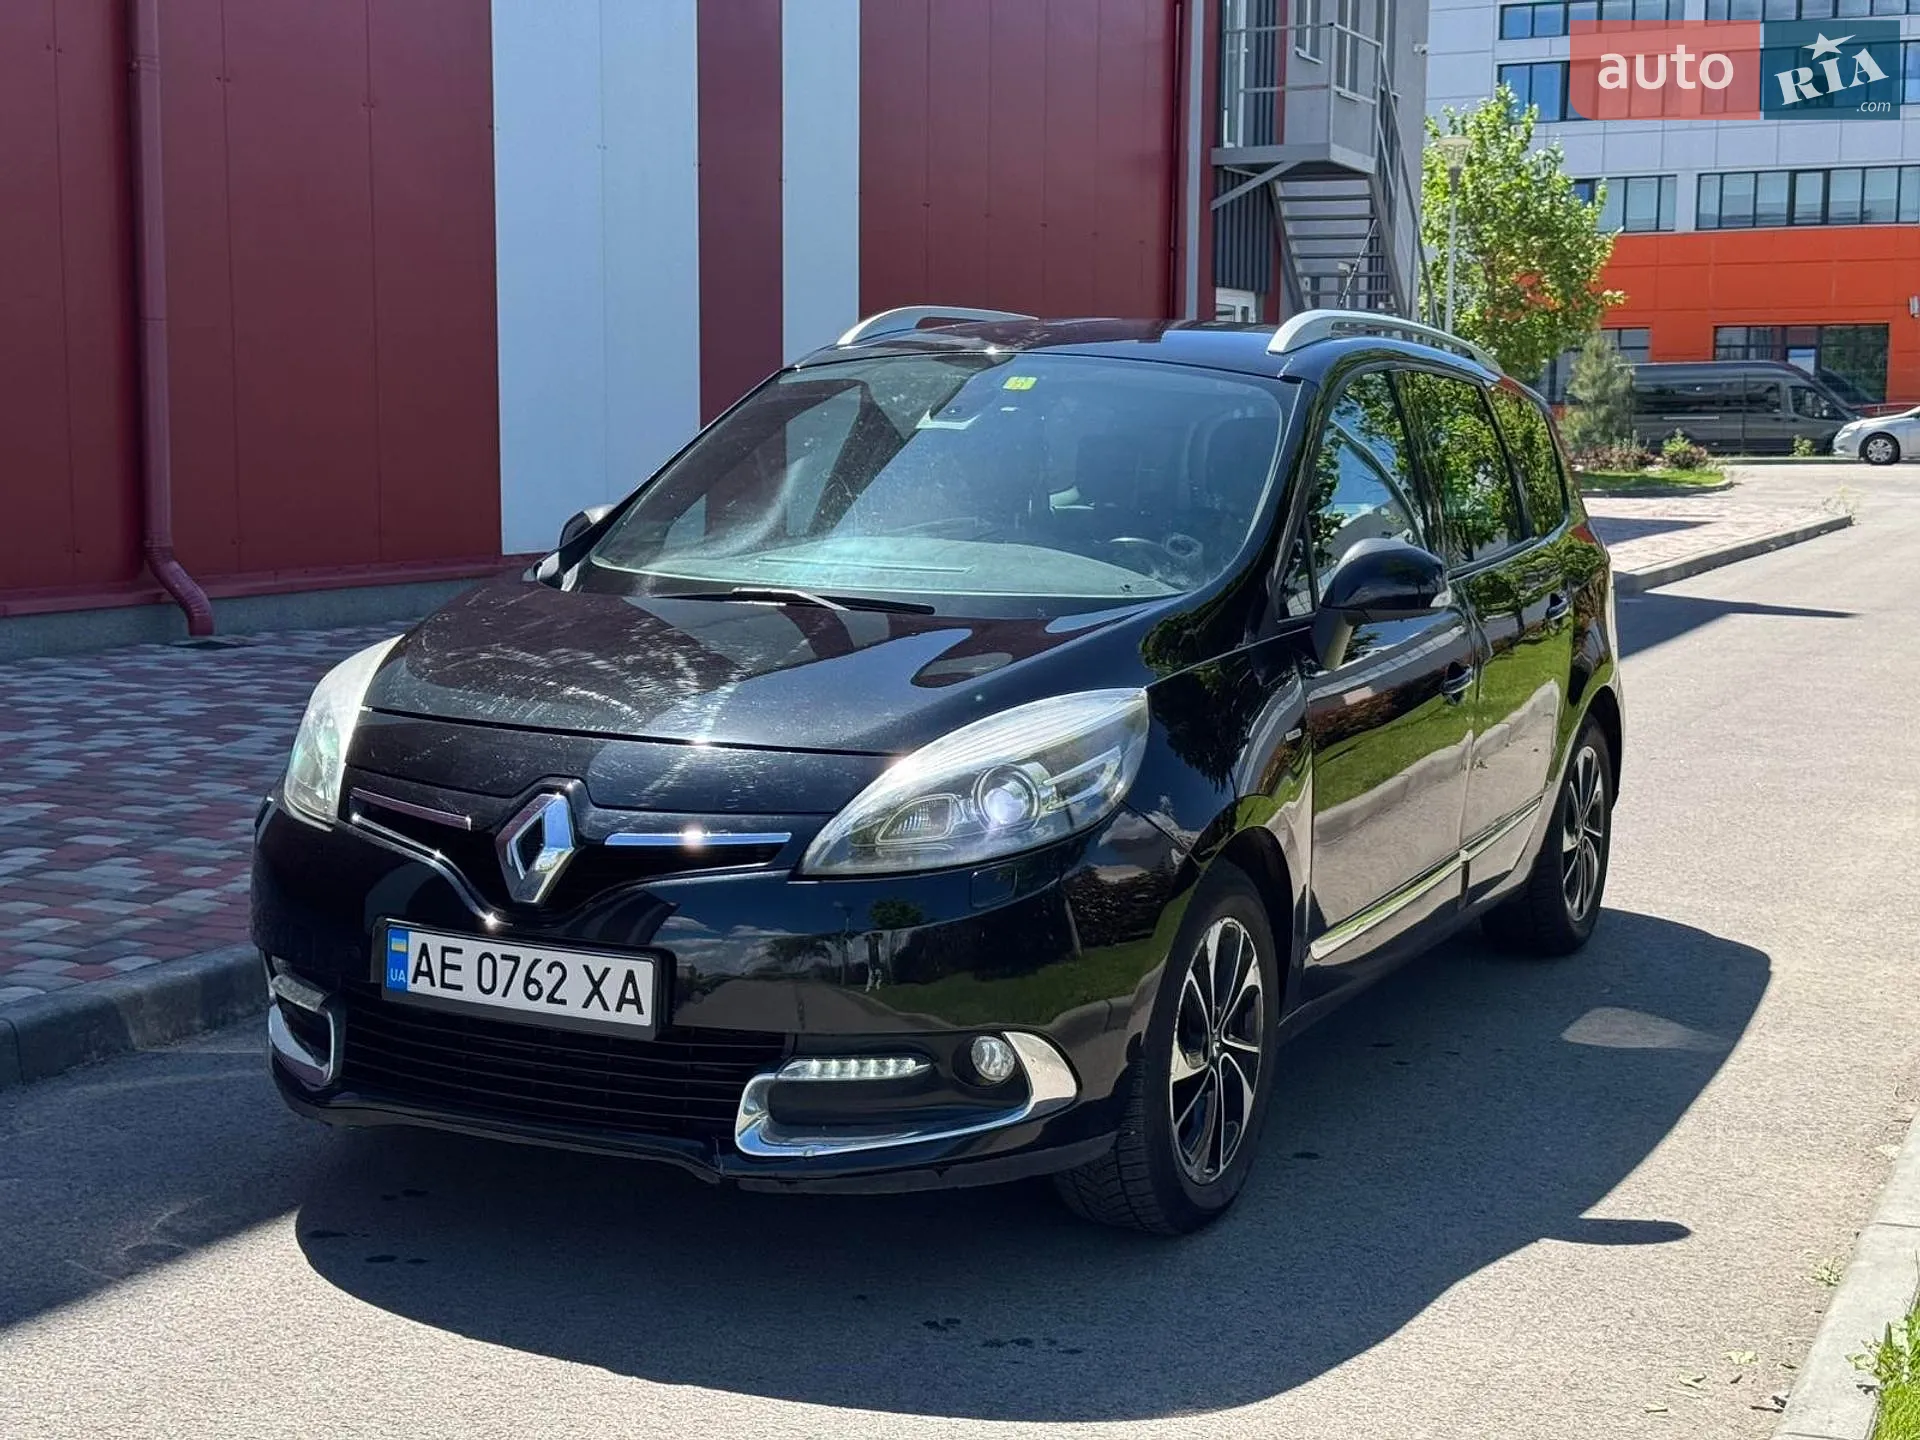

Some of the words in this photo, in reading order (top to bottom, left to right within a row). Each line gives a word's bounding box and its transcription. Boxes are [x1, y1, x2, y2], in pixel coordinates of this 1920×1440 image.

[390, 970, 406, 983] UA
[411, 942, 463, 991] AE
[477, 952, 567, 1005] 0762
[581, 964, 644, 1015] XA
